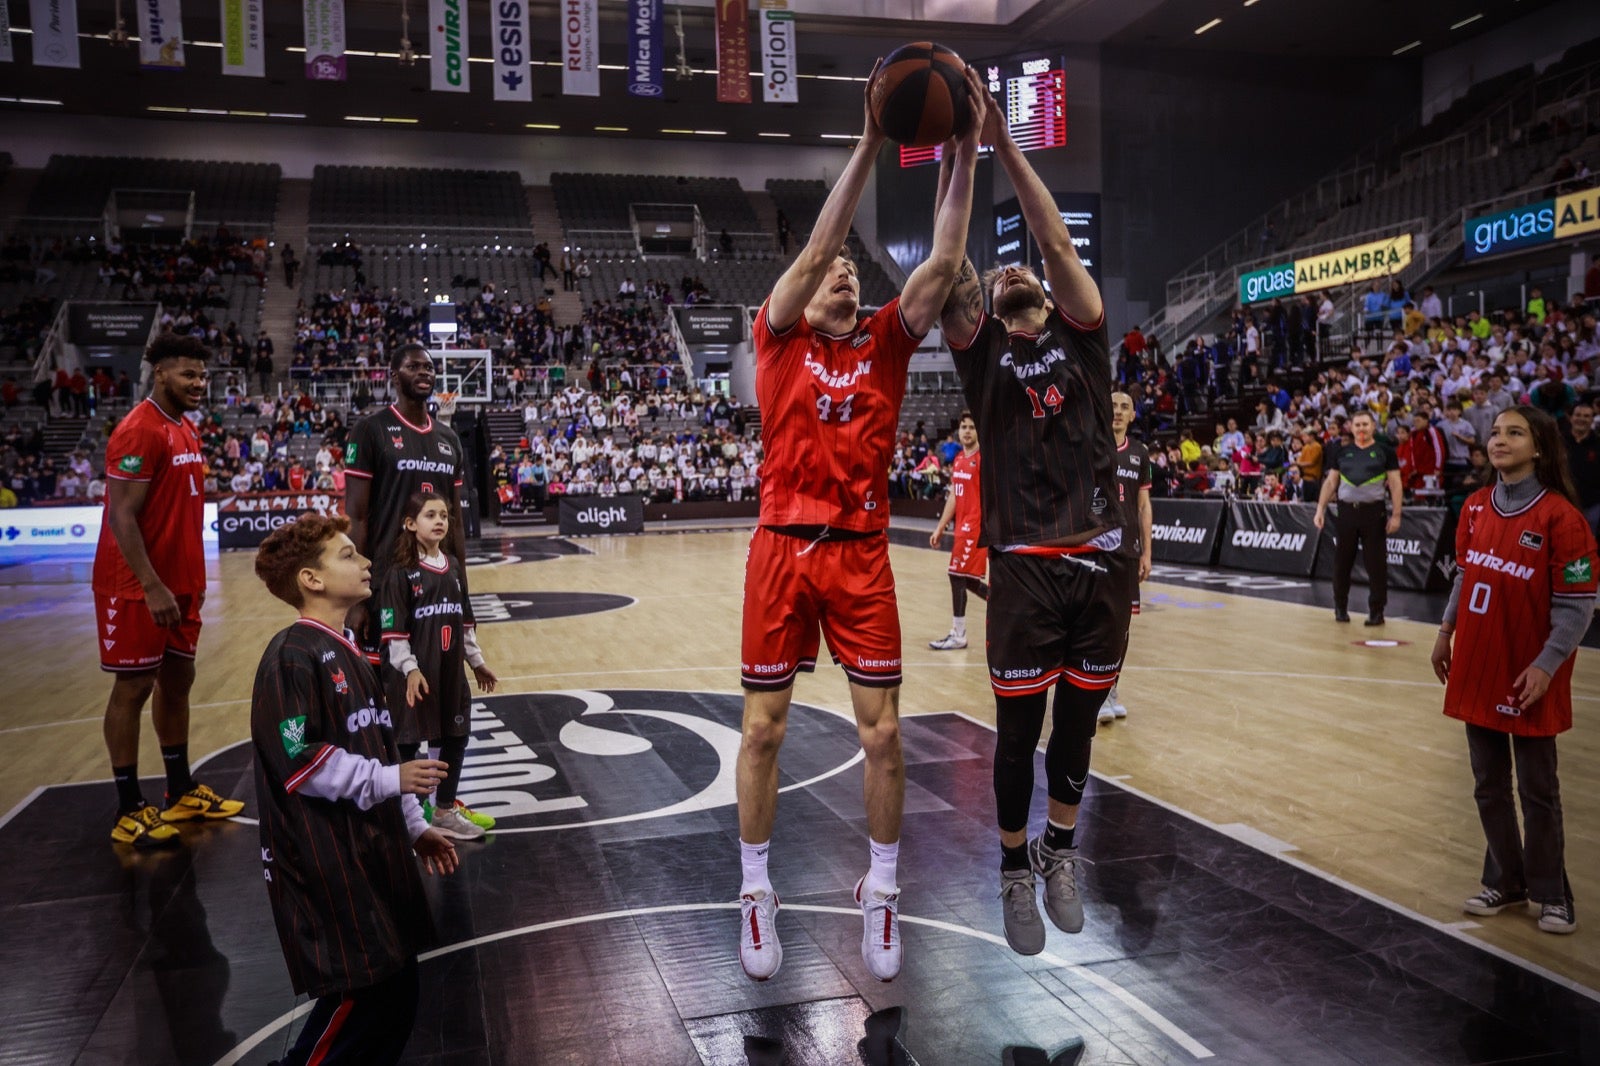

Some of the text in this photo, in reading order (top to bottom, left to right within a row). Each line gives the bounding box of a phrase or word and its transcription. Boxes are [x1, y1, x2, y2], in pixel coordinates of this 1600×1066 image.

[567, 0, 582, 72] RICOH
[635, 39, 651, 82] Mica
[737, 27, 749, 99] ANTONIO
[765, 21, 788, 85] orion
[1558, 196, 1600, 228] AL
[1297, 246, 1401, 284] ALHAMBRA
[815, 393, 855, 422] 44
[1026, 383, 1065, 418] 14
[397, 455, 455, 475] COVIRAN
[189, 474, 199, 496] 1
[576, 506, 628, 528] alight
[1150, 518, 1207, 544] COVIRAN
[1231, 523, 1307, 552] COVIRAN
[1468, 582, 1492, 616] 0
[754, 662, 784, 673] asisa
[1004, 667, 1037, 679] asisa
